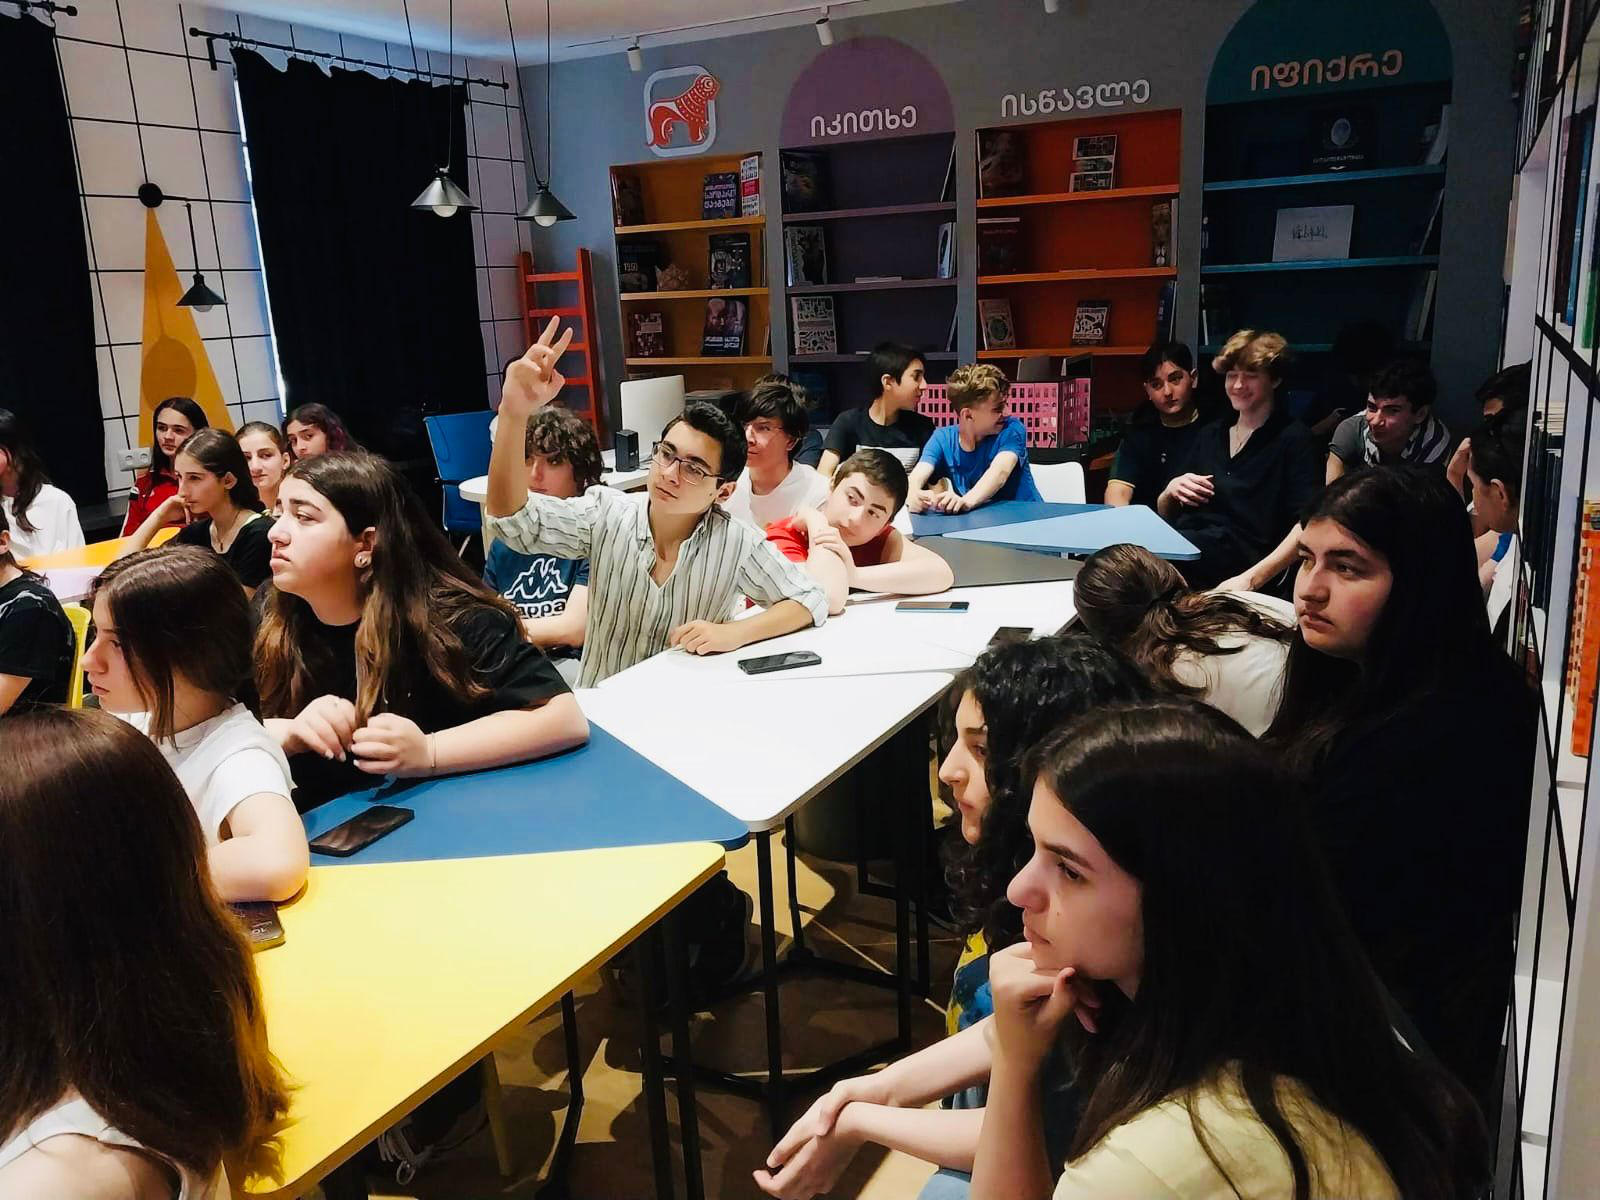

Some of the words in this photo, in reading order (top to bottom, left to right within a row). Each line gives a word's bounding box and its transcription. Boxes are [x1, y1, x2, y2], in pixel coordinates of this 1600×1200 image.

[1250, 50, 1404, 91] იფიქრე
[1001, 79, 1151, 118] ისწავლე
[811, 105, 918, 138] იკითხე
[511, 598, 567, 618] appa
